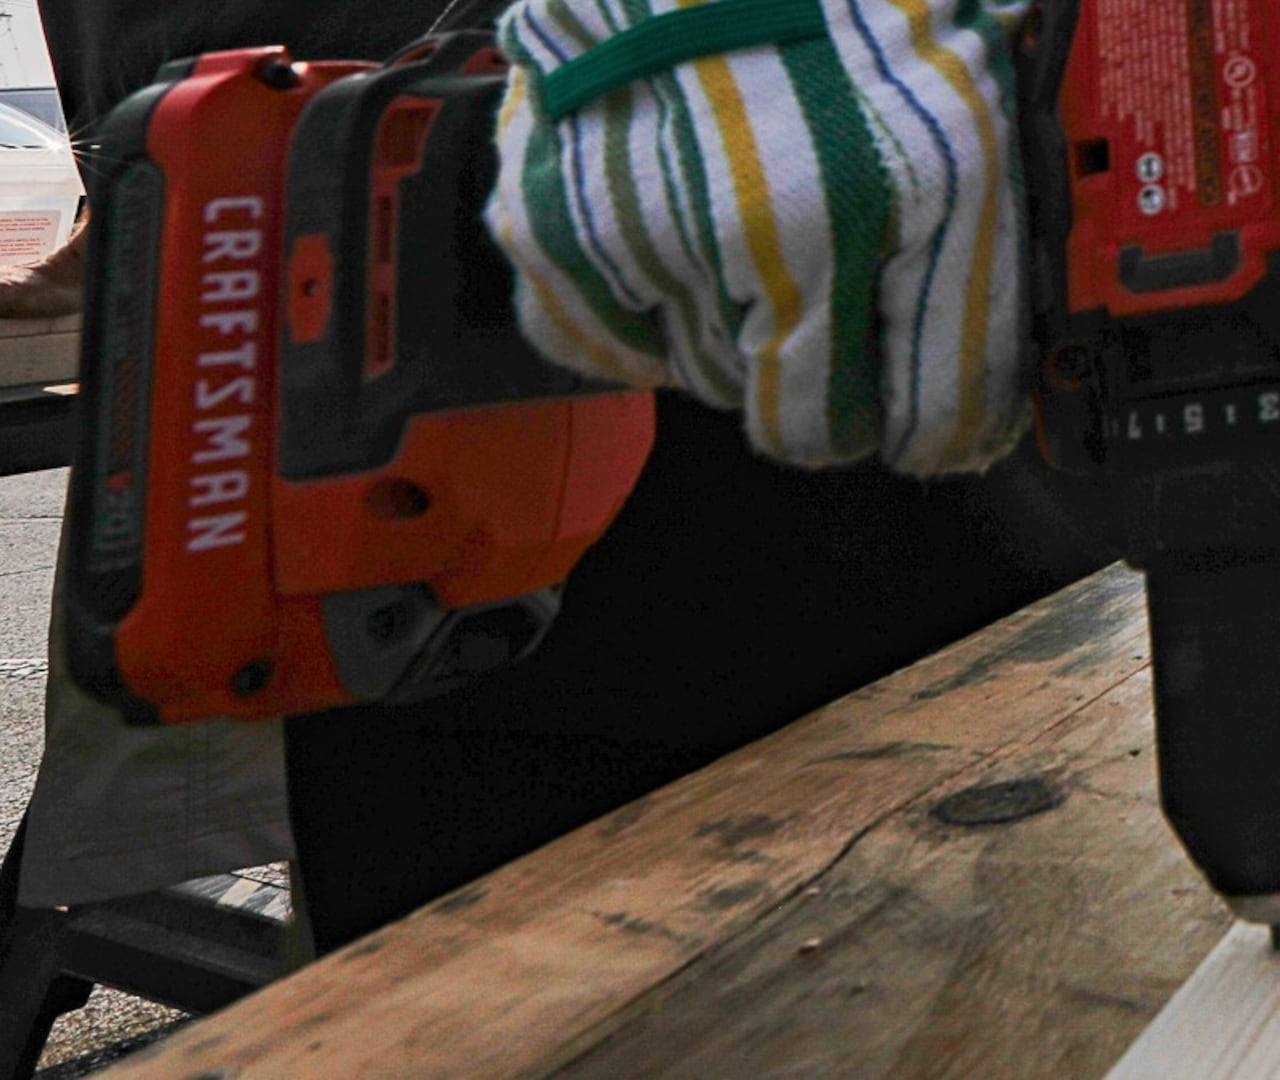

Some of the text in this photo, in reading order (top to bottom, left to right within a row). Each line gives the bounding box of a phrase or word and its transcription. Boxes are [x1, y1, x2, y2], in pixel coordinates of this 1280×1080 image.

[186, 195, 264, 553] CRAFTSMAN
[1183, 402, 1204, 433] 5
[1257, 392, 1280, 421] 3
[1128, 411, 1142, 439] 7
